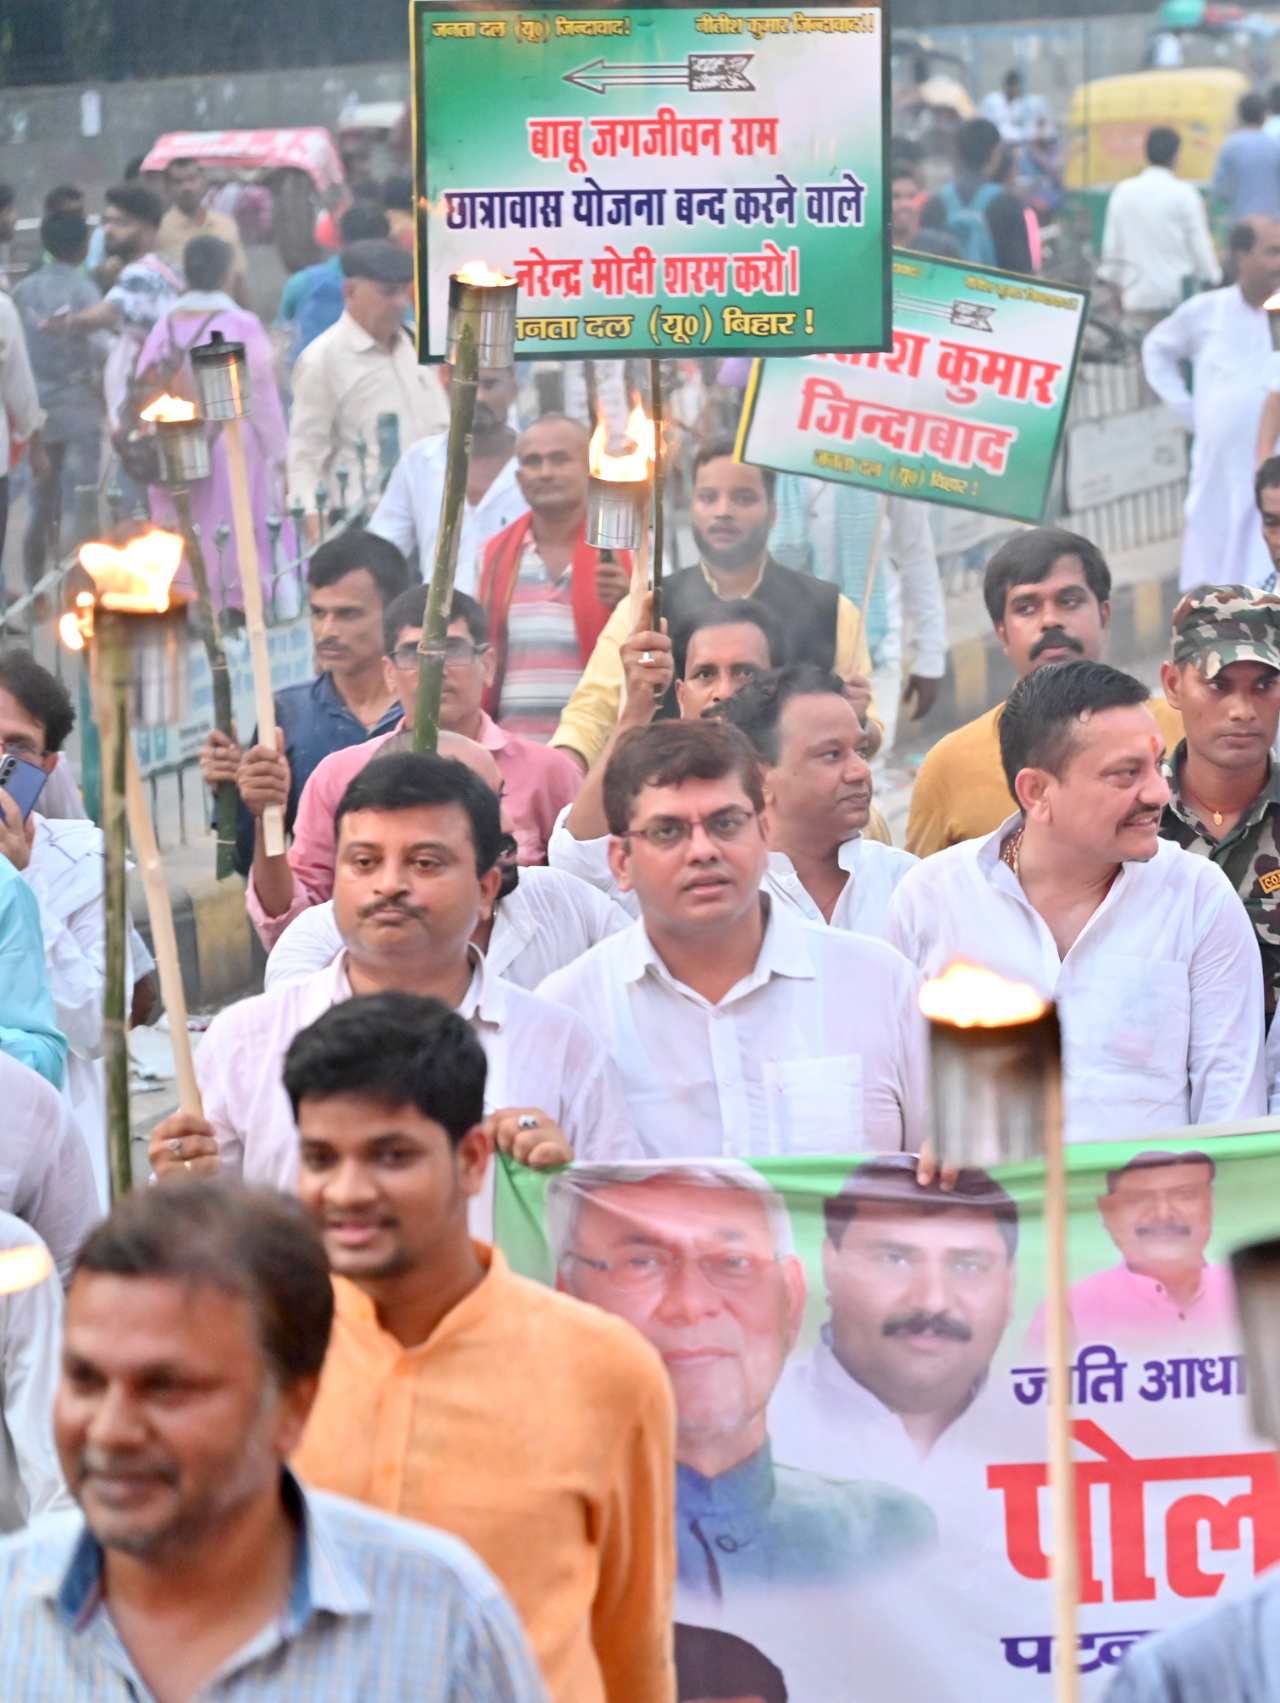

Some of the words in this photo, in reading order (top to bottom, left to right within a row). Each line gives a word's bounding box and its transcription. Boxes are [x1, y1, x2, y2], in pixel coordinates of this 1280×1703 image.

[479, 21, 507, 38] दल
[745, 16, 790, 40] कुमार
[529, 120, 588, 173] बाबू
[590, 106, 723, 157] जगजीवन
[730, 118, 779, 156] राम
[444, 190, 564, 229] छात्रावास
[572, 177, 667, 227] योजना
[674, 187, 727, 225] बन्द
[733, 174, 798, 224] करने
[805, 173, 865, 224] वाले
[513, 247, 583, 298] नरेन्द्र
[591, 245, 657, 296] मोदी
[663, 256, 728, 294] शरम
[585, 315, 633, 338] दल
[722, 305, 796, 336] बिहार
[939, 340, 1062, 404] कुमार
[797, 377, 1012, 471] जिन्दाबाद
[1138, 1355, 1248, 1402] आधा
